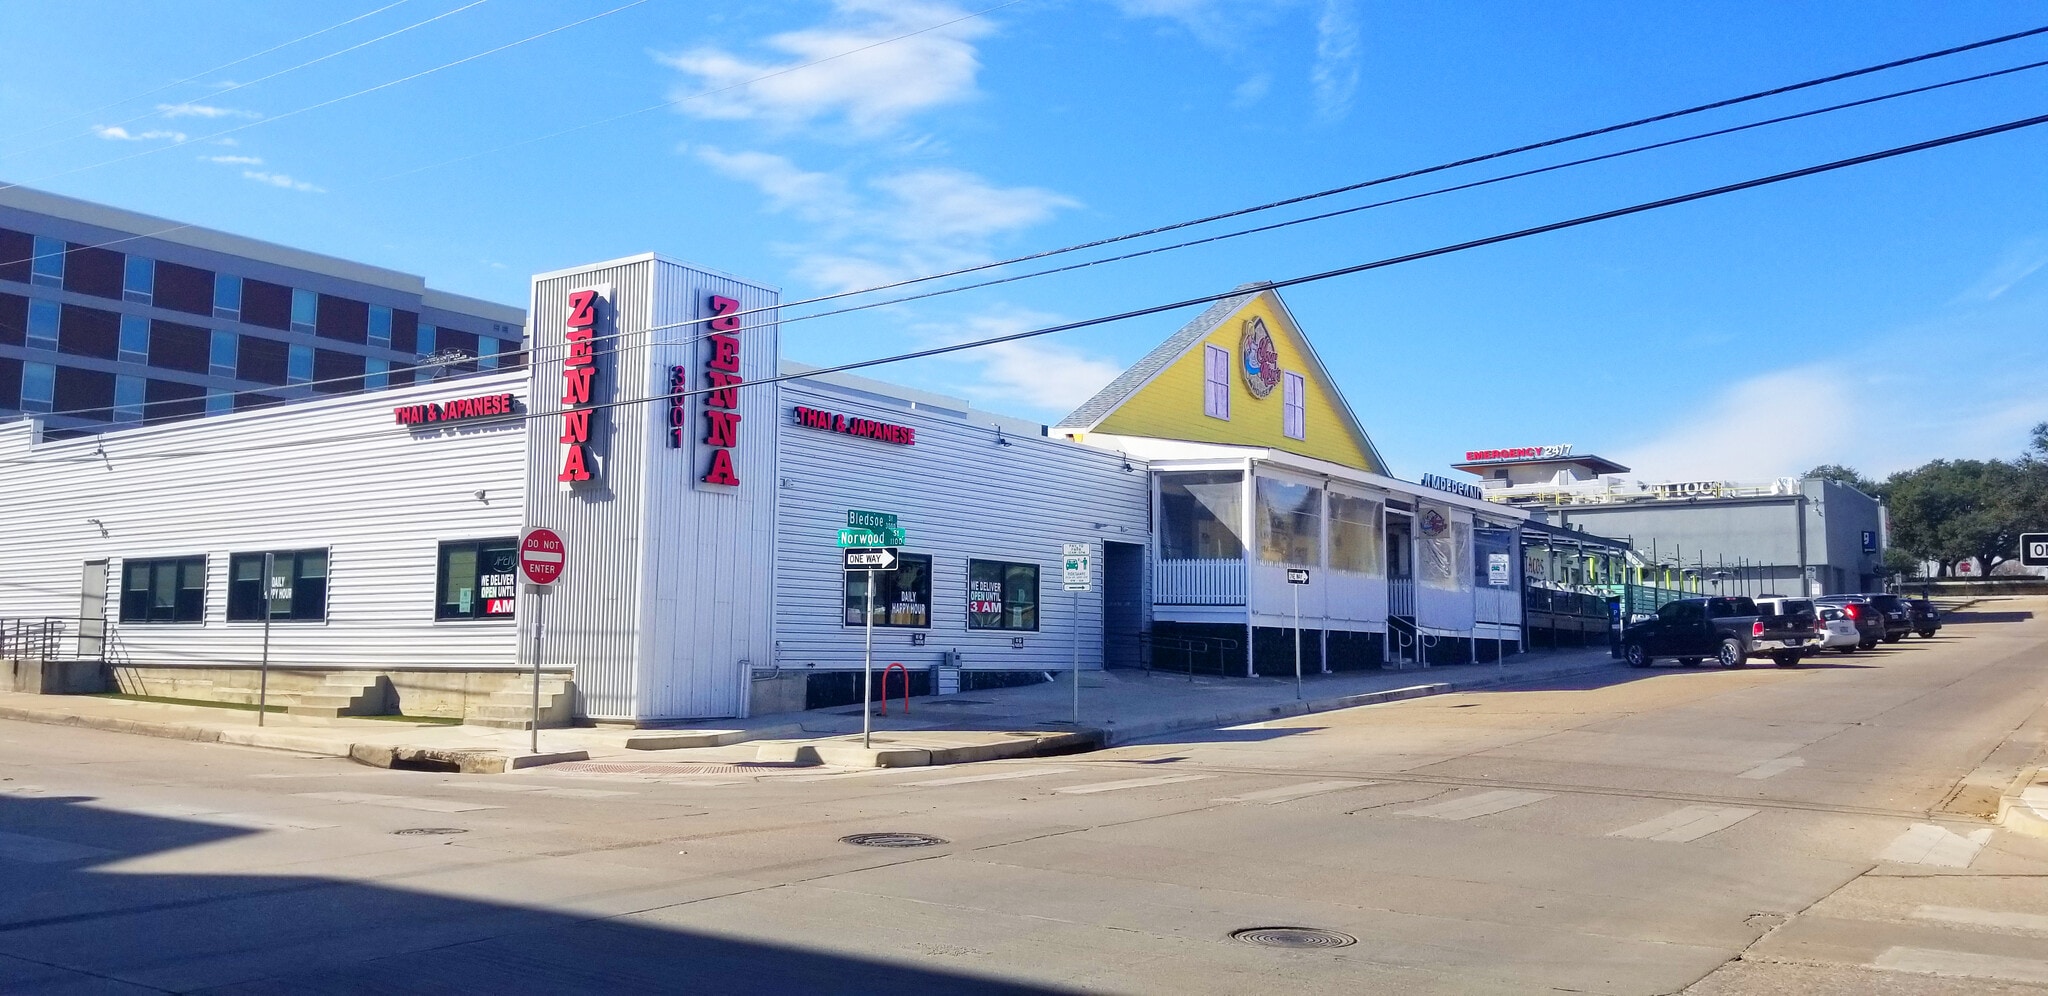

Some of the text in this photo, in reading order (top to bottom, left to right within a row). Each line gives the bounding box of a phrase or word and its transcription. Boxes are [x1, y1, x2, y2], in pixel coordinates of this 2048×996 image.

[558, 290, 598, 482] ZENNA
[704, 295, 742, 486] ZENNA
[394, 393, 512, 425] THAI & JAPANESE
[671, 365, 686, 449] 3001
[797, 406, 915, 445] THAI & JAPANESE
[1465, 443, 1573, 461] EMERGENCY 24/7
[850, 511, 884, 527] Bledsoe
[841, 529, 900, 544] Norwood St
[527, 539, 559, 550] DO NOT
[2034, 543, 2048, 557] O
[849, 554, 881, 563] ONE WAY
[529, 563, 556, 574] ENTER
[271, 576, 286, 587] DAILY
[481, 574, 514, 586] WE DELIVER
[970, 581, 1001, 592] WE DELIVER
[279, 588, 292, 599] HOUR
[481, 585, 515, 598] OPEN UNTIL
[901, 590, 917, 602] DAILY
[970, 591, 1001, 602] OPEN UNTIL
[492, 600, 514, 613] AM
[891, 602, 926, 615] HAPPY HOUR
[970, 601, 1001, 613] 3 AM
